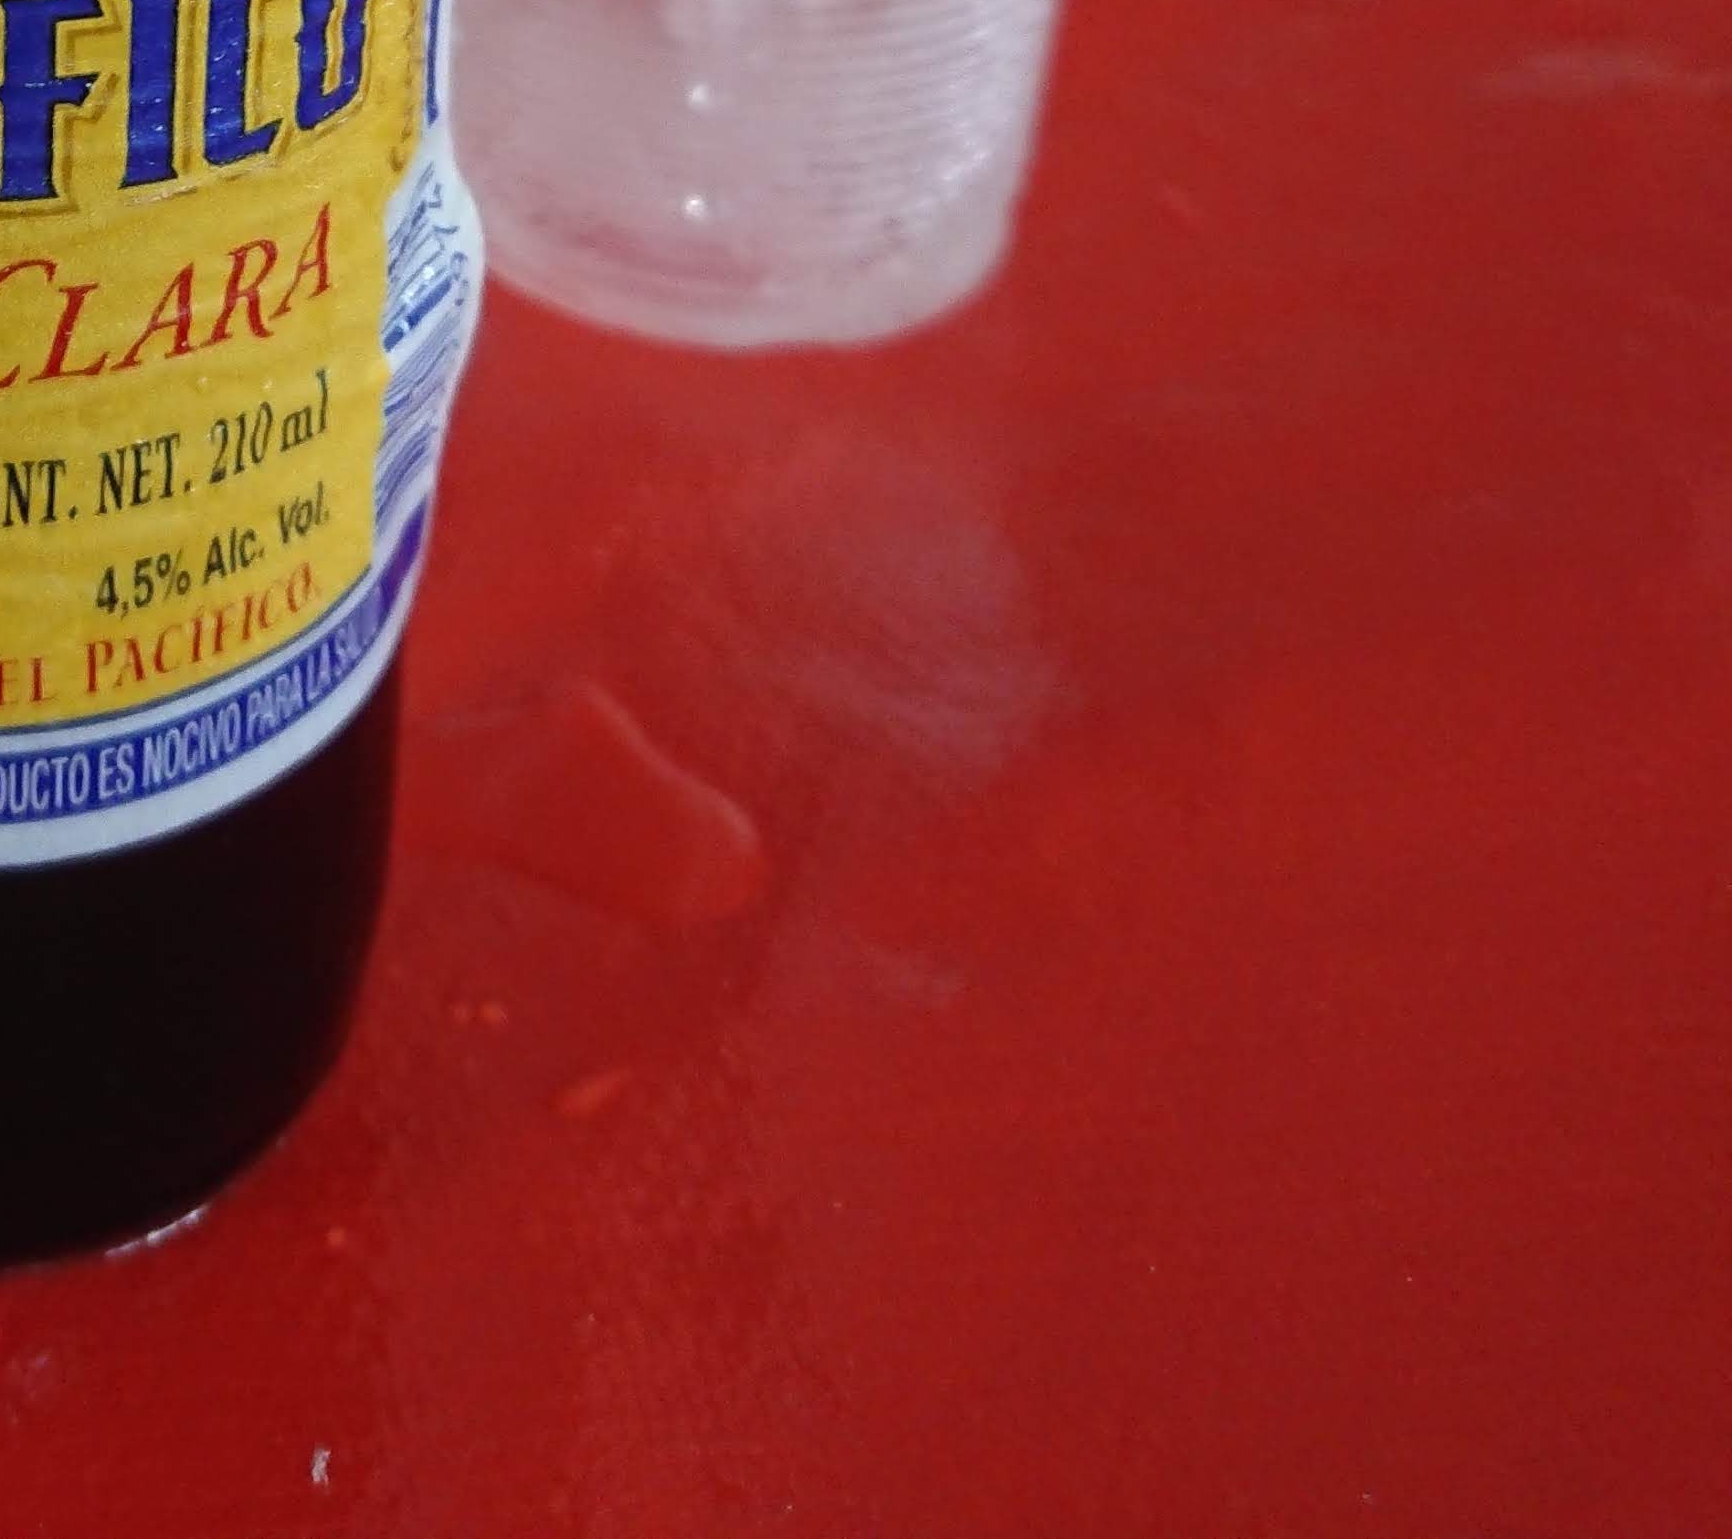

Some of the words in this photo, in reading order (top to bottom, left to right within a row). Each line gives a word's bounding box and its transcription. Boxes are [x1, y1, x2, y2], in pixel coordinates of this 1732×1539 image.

[95, 432, 192, 517] NET.
[208, 401, 274, 485] 210
[280, 368, 330, 453] ml
[96, 547, 192, 619] 4,5%
[203, 526, 266, 585] Alc.
[277, 480, 330, 544] Vol.
[97, 741, 135, 801] ES
[141, 700, 242, 788] NOCIVO
